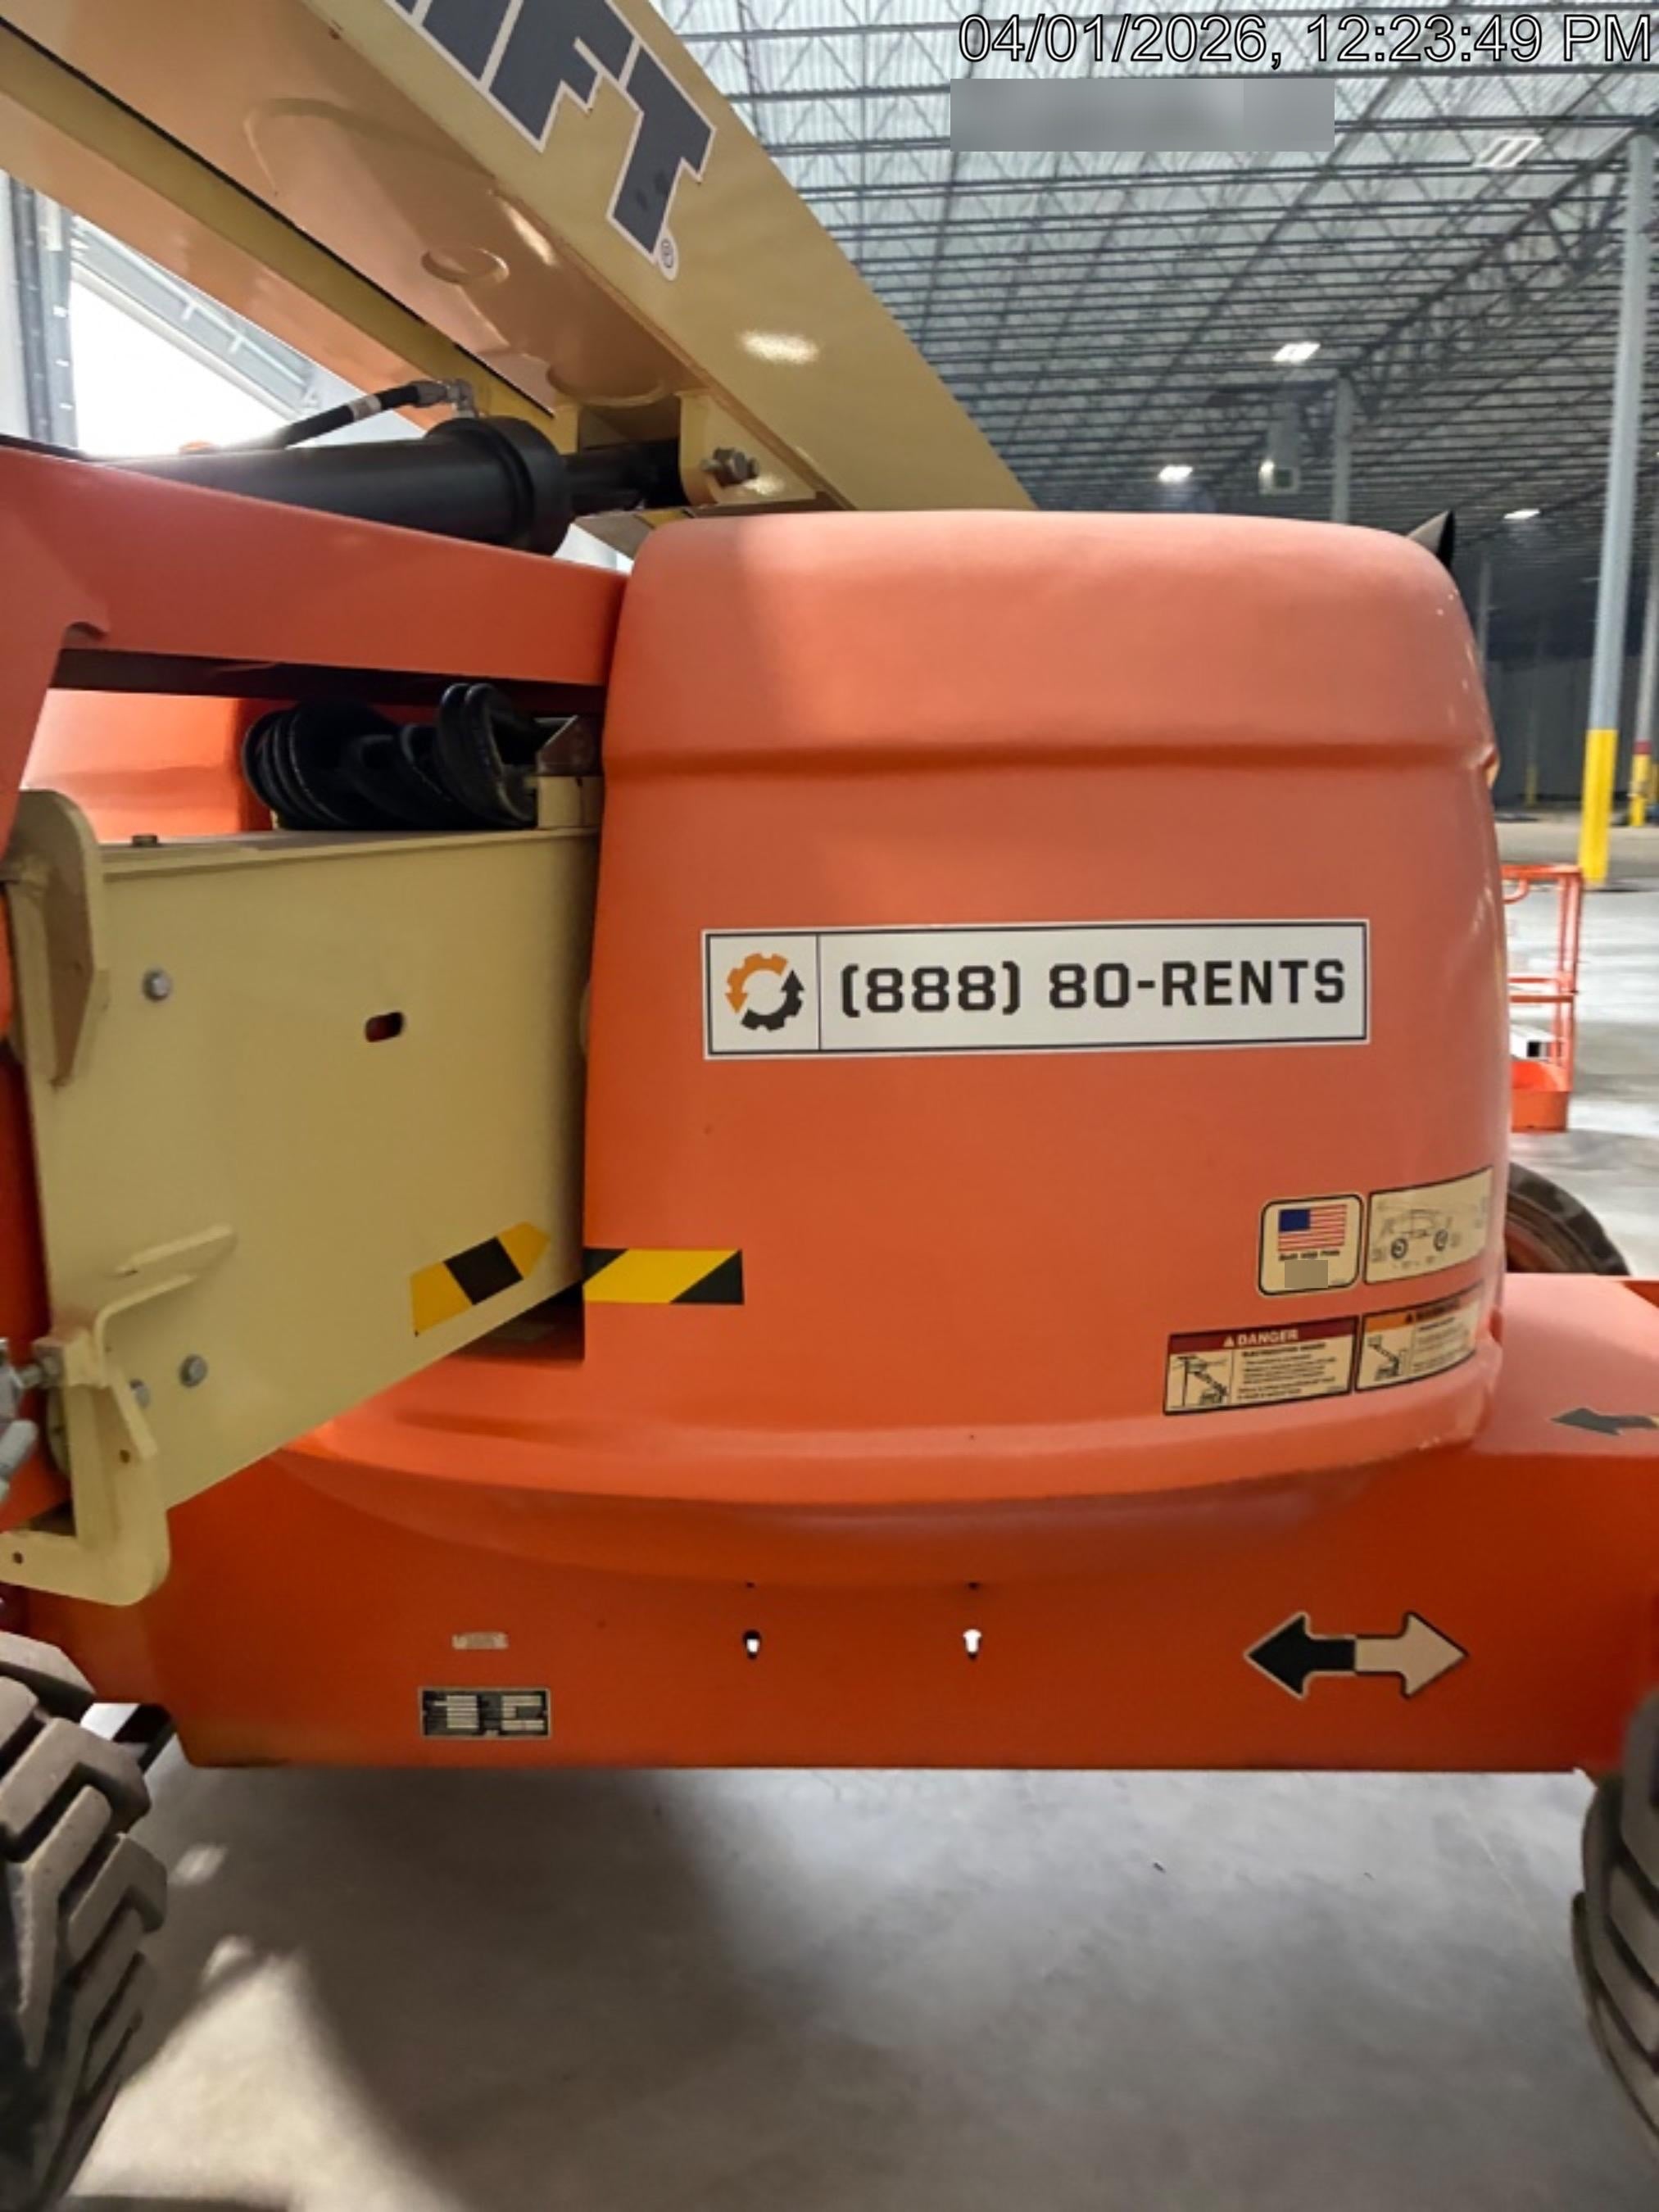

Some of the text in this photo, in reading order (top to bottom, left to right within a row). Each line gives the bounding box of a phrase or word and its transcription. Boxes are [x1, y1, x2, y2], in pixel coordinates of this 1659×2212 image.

[841, 959, 1346, 1019] (888) 80-RENTS
[1237, 1328, 1299, 1346] DANGER
